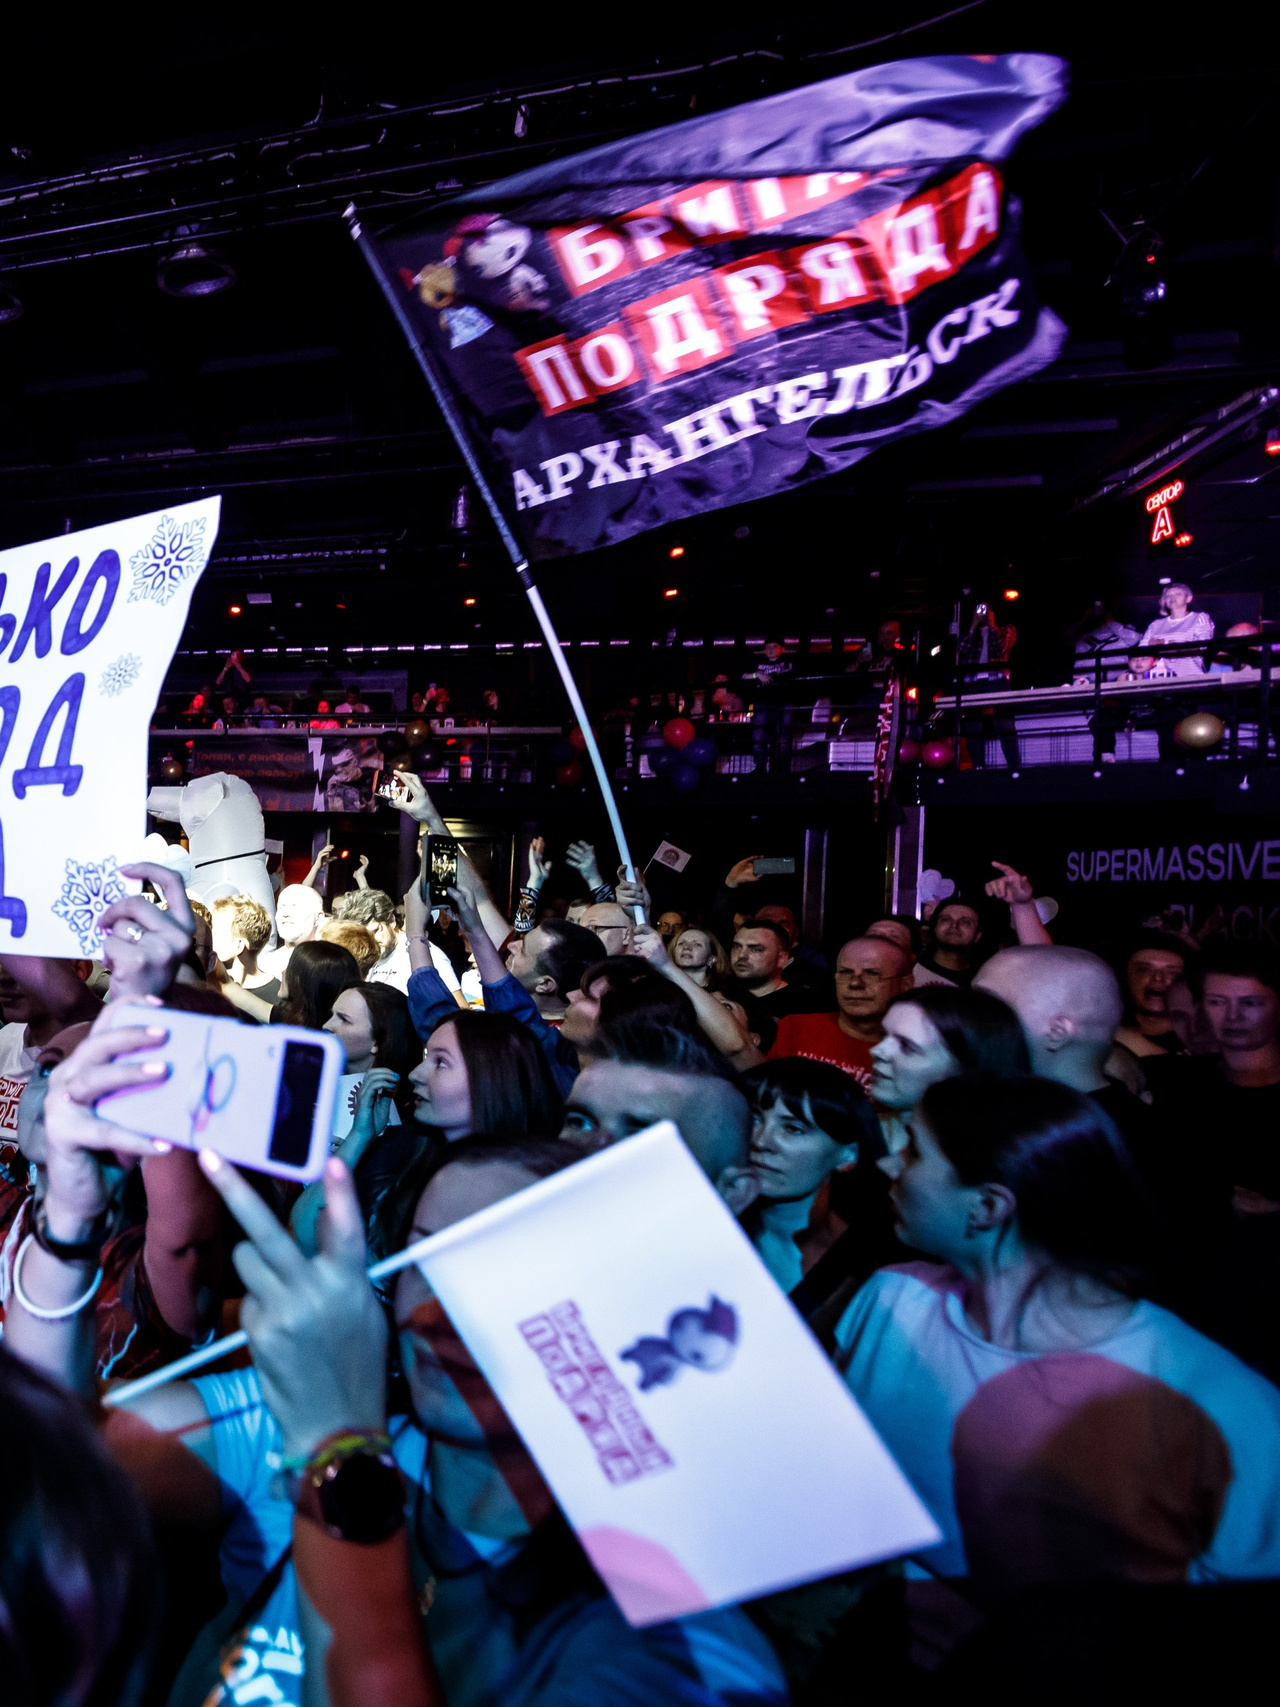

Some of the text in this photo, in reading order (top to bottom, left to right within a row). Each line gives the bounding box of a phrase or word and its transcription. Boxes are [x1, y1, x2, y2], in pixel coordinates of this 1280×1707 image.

[514, 278, 1020, 511] АРХАНГЕЛЬСК
[524, 170, 1001, 410] ПОДРЯДА
[1065, 839, 1280, 882] SUPERMASSIVE
